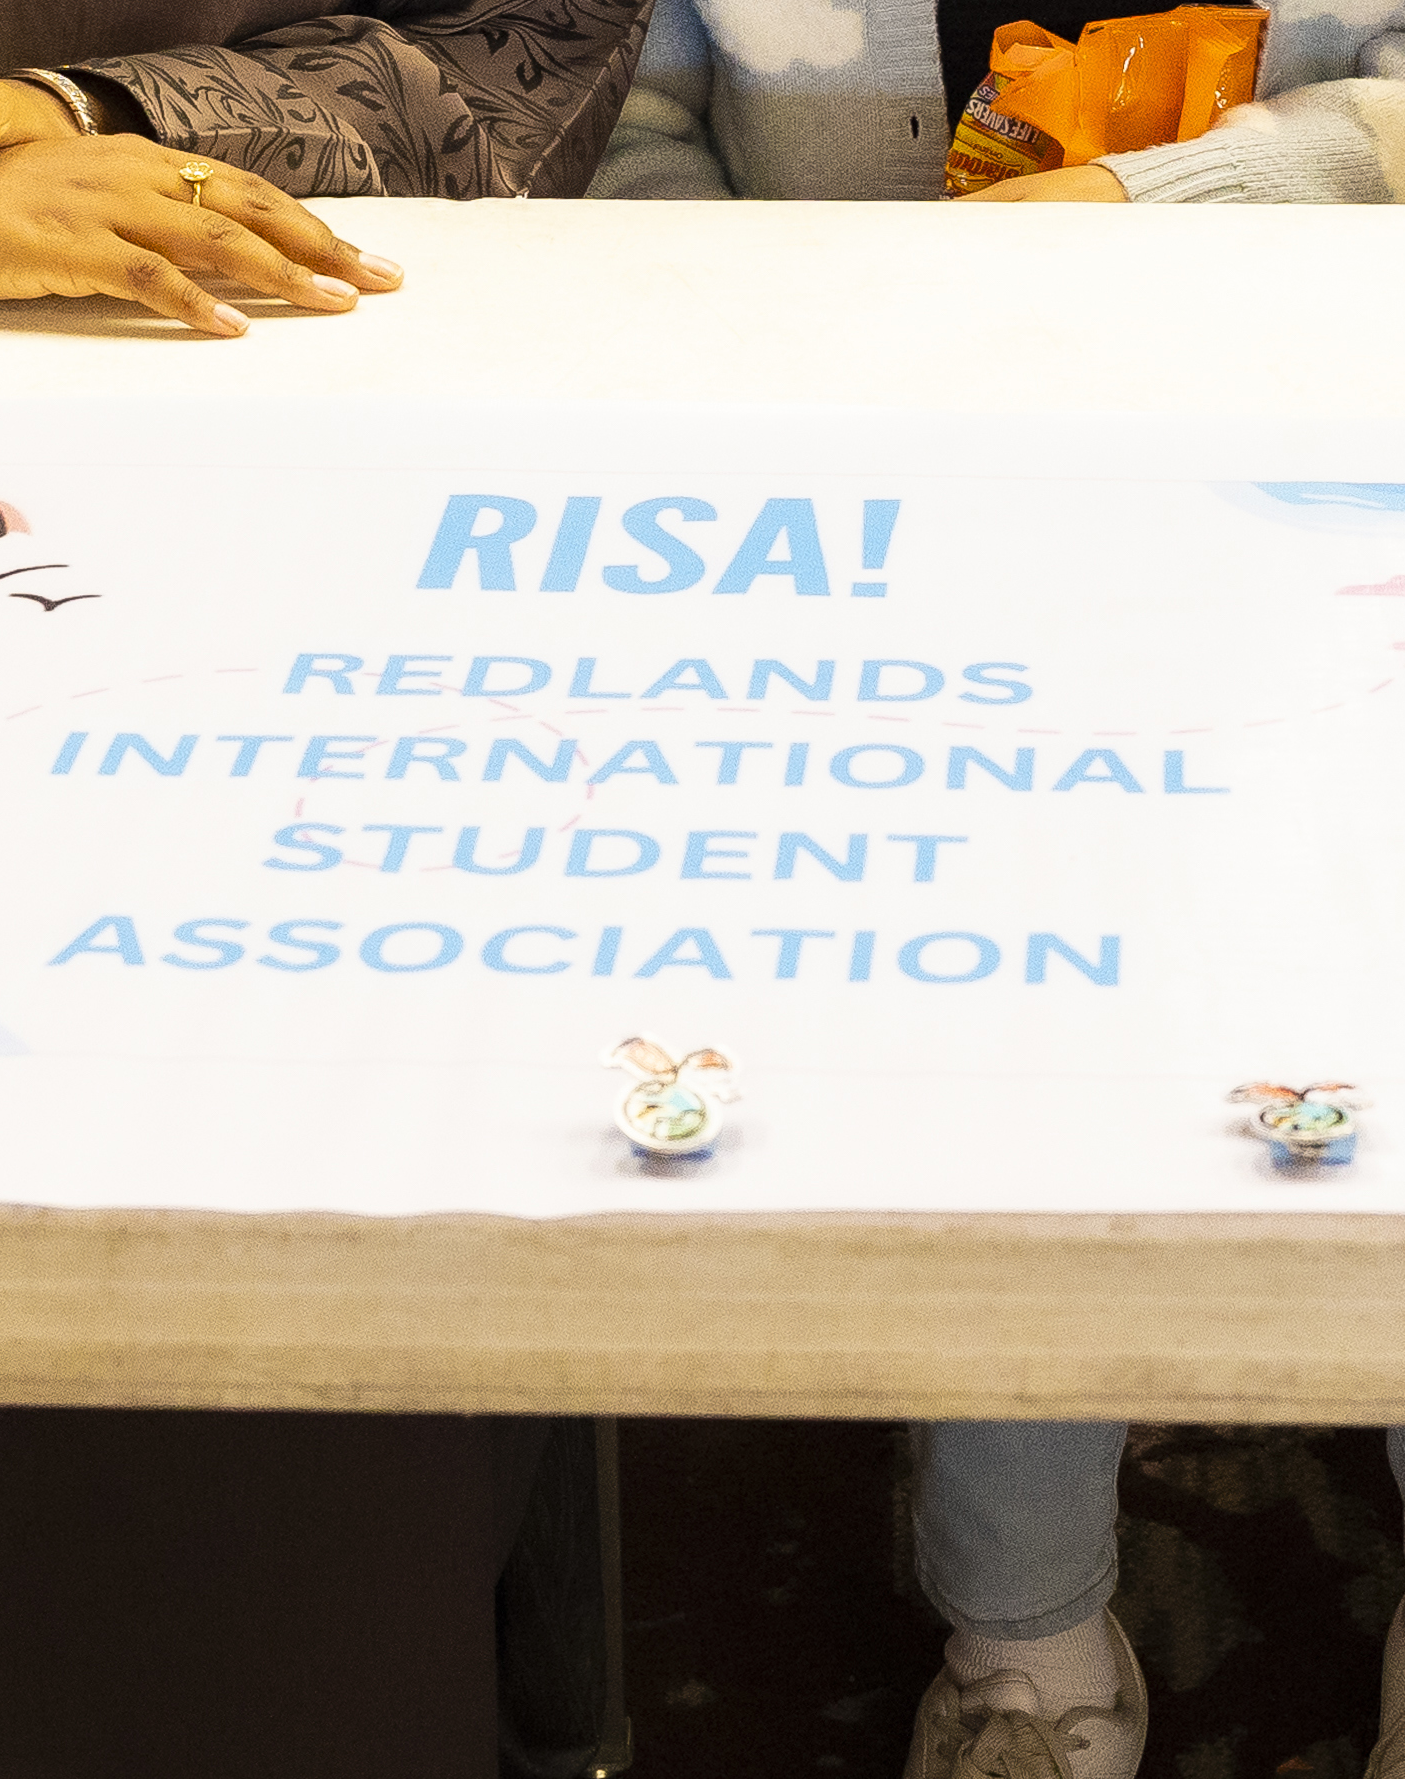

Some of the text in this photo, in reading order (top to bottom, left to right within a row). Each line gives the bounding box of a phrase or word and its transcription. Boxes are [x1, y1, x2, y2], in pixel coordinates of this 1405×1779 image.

[418, 495, 899, 598] RISA!
[286, 654, 1033, 705] REDLANDS
[51, 732, 1231, 795] INTERNATIONAL
[262, 824, 969, 882] STUDENT
[47, 915, 1125, 988] ASSOCIATION
